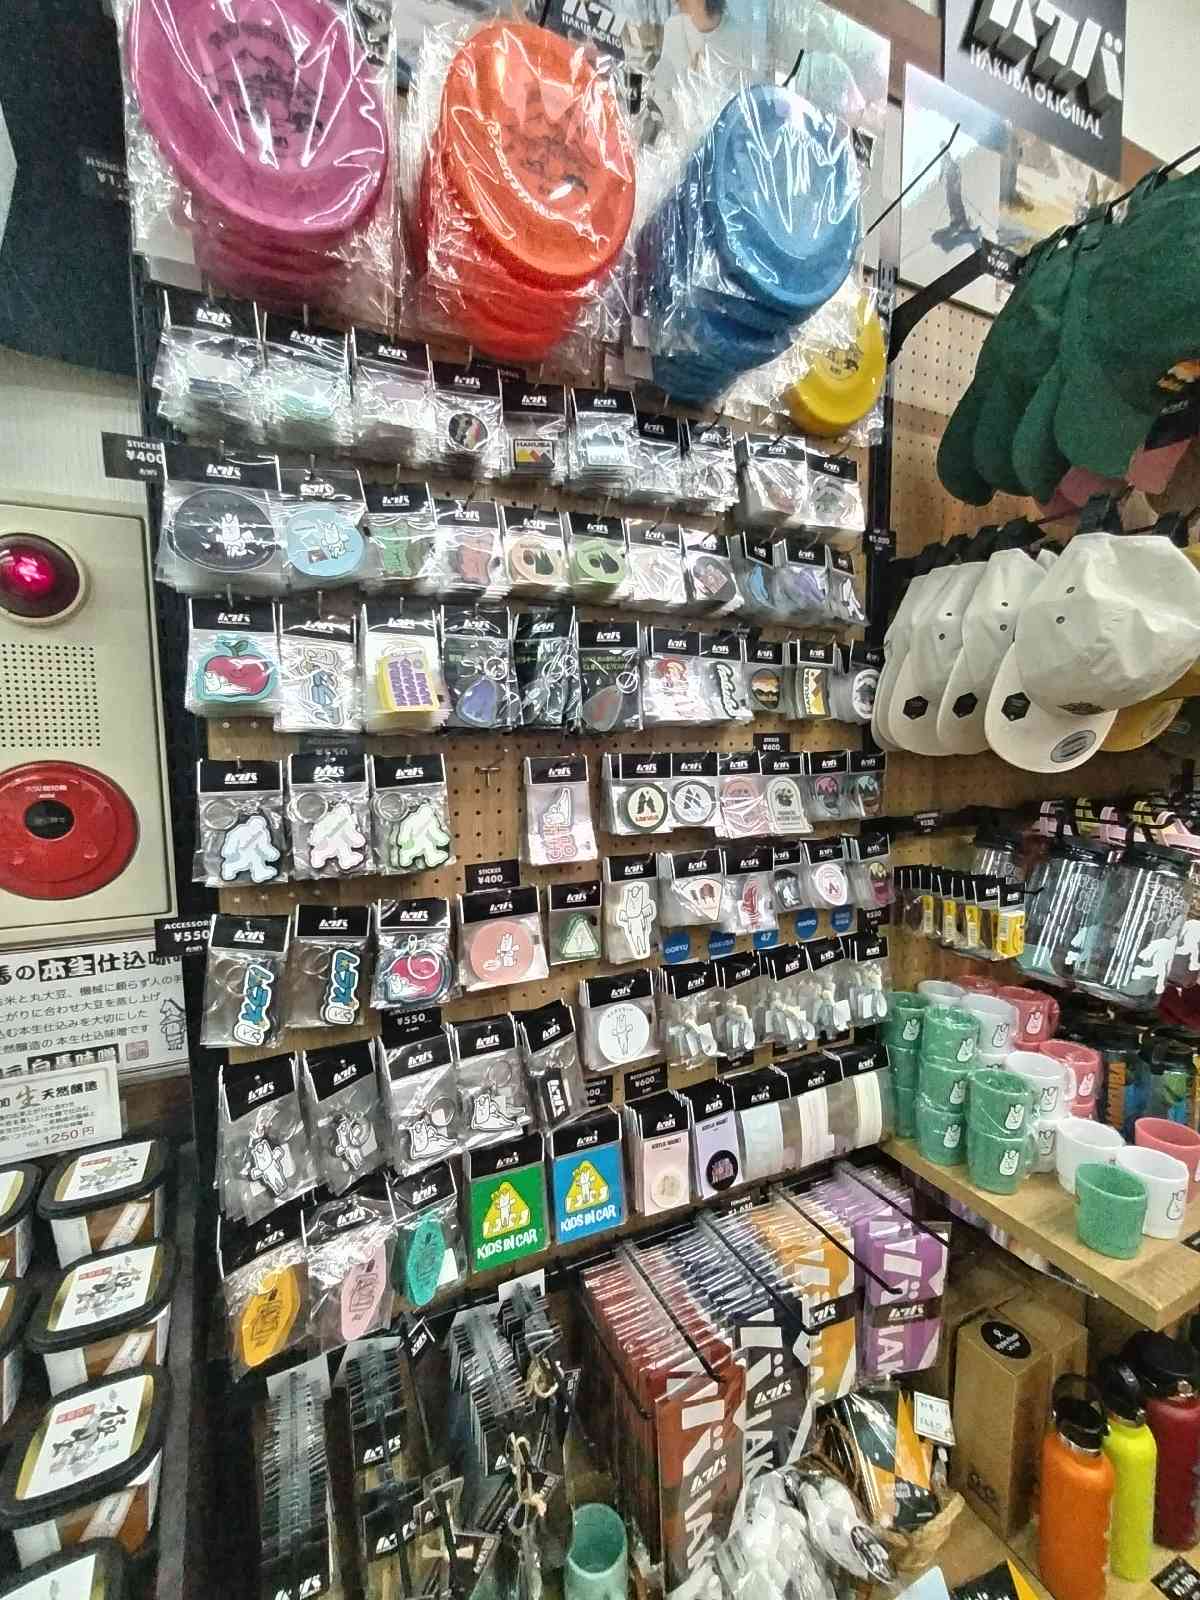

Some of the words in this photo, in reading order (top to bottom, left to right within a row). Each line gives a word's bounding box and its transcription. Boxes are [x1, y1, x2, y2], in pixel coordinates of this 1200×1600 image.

[969, 43, 1034, 99] HAKUBA
[1033, 84, 1104, 139] ORIGINAL
[478, 866, 502, 875] STICKER
[478, 873, 503, 884] ¥400
[174, 930, 210, 943] ¥550
[760, 931, 772, 940] 47
[397, 1013, 426, 1027] ¥550
[44, 1126, 95, 1144] 1250円
[560, 1213, 584, 1232] KIDS
[584, 1209, 596, 1226] IN
[595, 1204, 616, 1222] CAR
[477, 1239, 503, 1260] KIDS
[503, 1235, 515, 1251] IN
[515, 1228, 538, 1248] CAR
